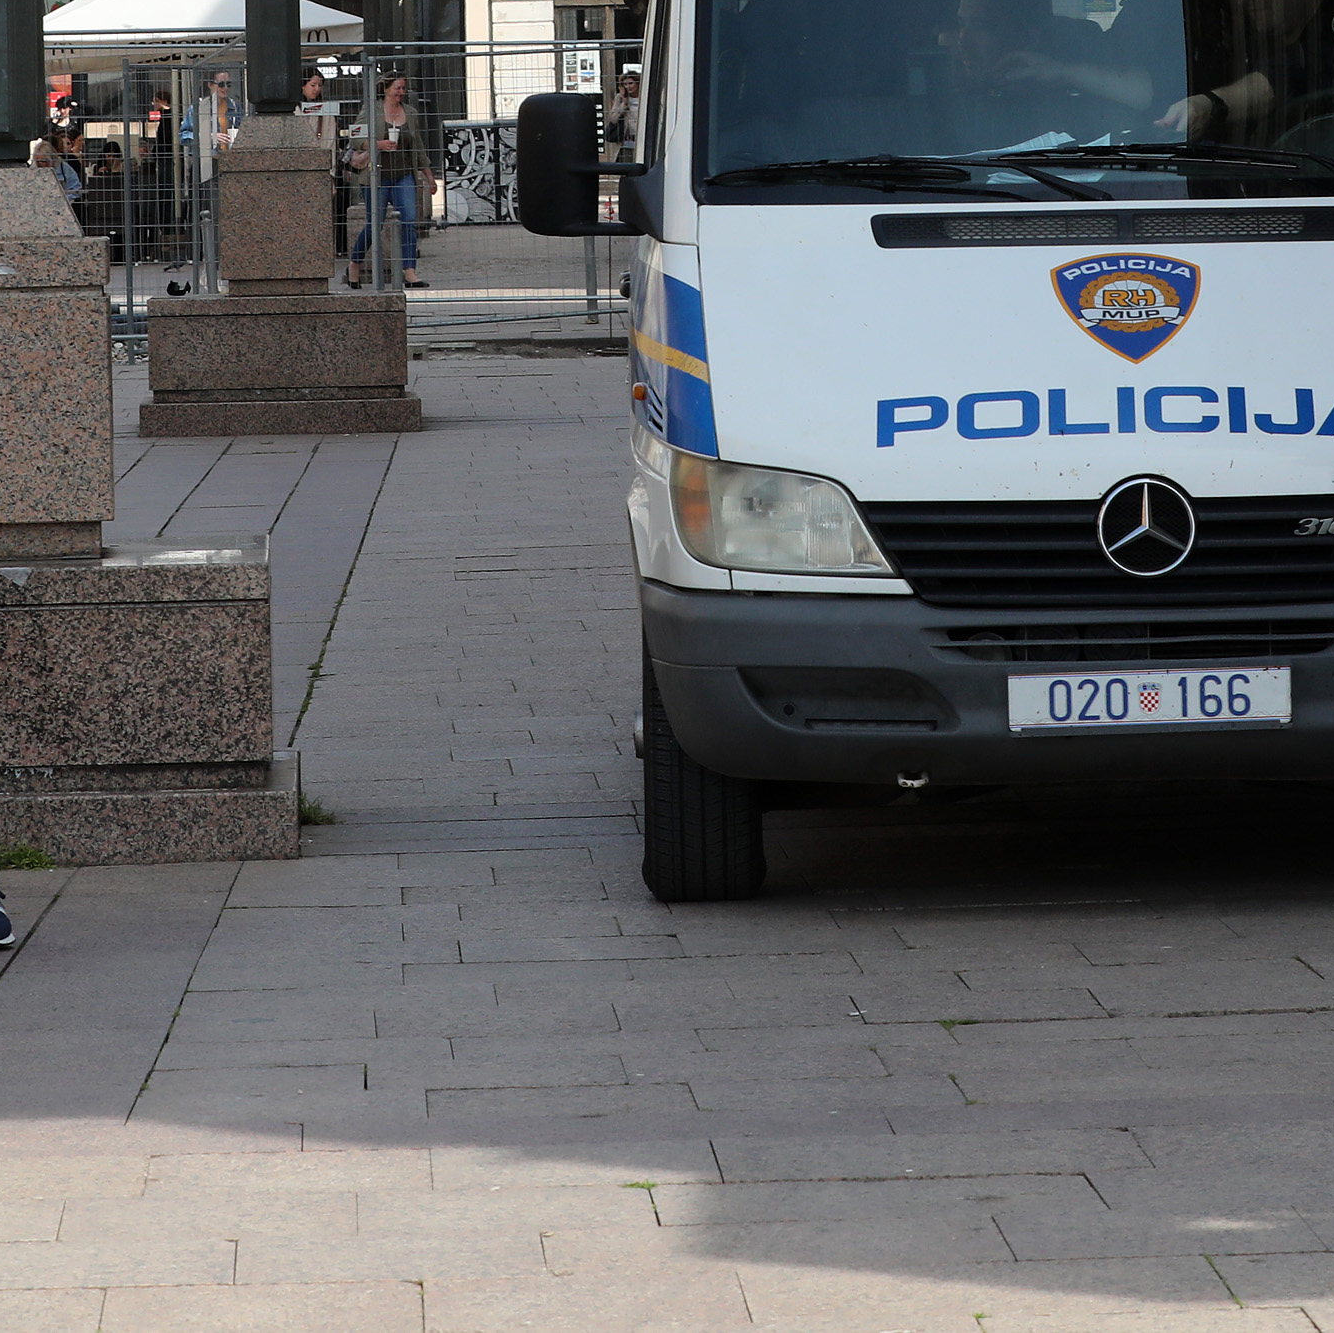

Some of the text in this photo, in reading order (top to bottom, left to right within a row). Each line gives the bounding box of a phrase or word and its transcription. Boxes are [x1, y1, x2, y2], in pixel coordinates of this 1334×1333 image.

[1062, 259, 1192, 281] POLICIJA
[1102, 288, 1156, 307] RH
[1102, 310, 1160, 319] MUP
[1048, 673, 1251, 722] 020 166
